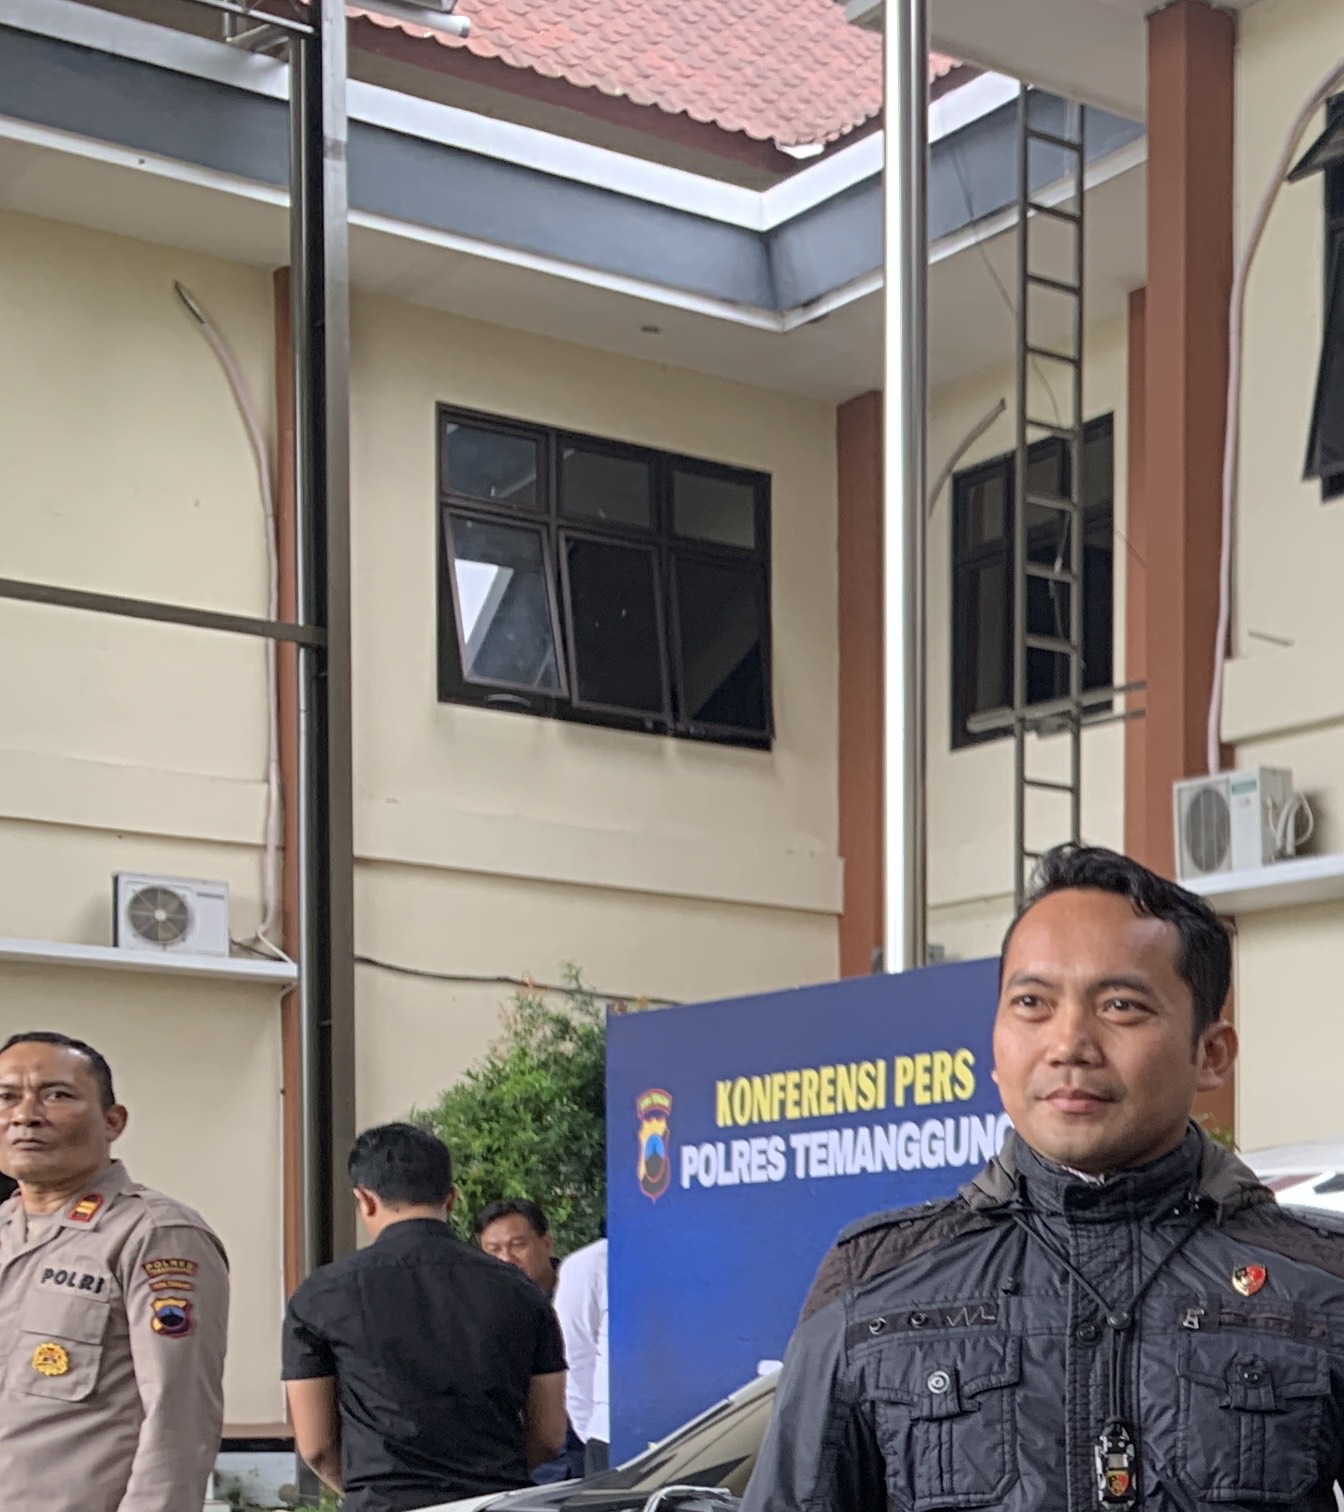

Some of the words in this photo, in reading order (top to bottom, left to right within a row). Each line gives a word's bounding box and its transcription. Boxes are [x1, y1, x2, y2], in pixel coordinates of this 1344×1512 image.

[715, 1059, 886, 1127] KONFERENSI
[895, 1048, 975, 1107] PERS
[680, 1136, 786, 1189] POLRES
[41, 1268, 105, 1294] POLRI
